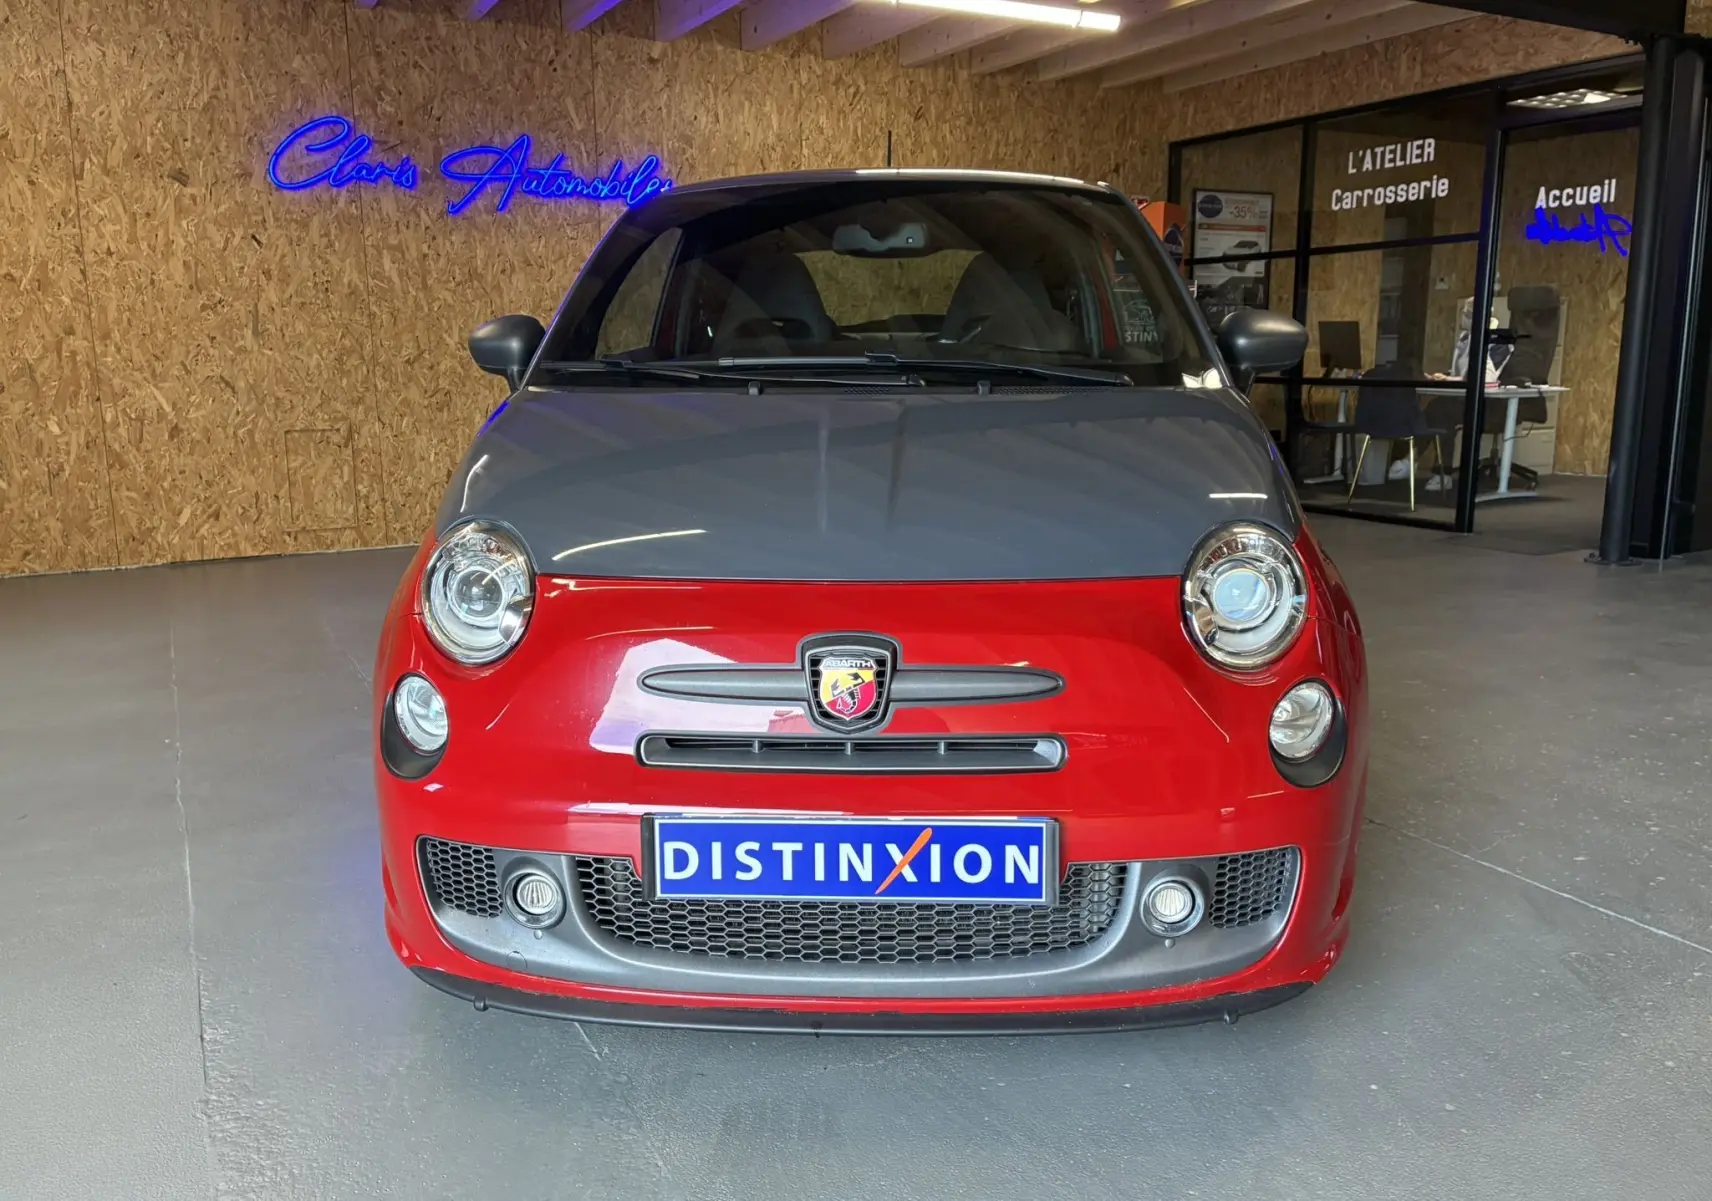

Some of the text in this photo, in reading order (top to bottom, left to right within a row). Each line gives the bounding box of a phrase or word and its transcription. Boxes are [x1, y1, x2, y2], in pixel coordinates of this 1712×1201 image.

[267, 115, 415, 190] Claris
[1347, 137, 1436, 175] L'ATELIER
[1331, 175, 1449, 211] Carrosserie
[1534, 178, 1617, 209] Accueil
[824, 659, 872, 668] ABARTH
[663, 827, 1039, 894] DISTINXION
